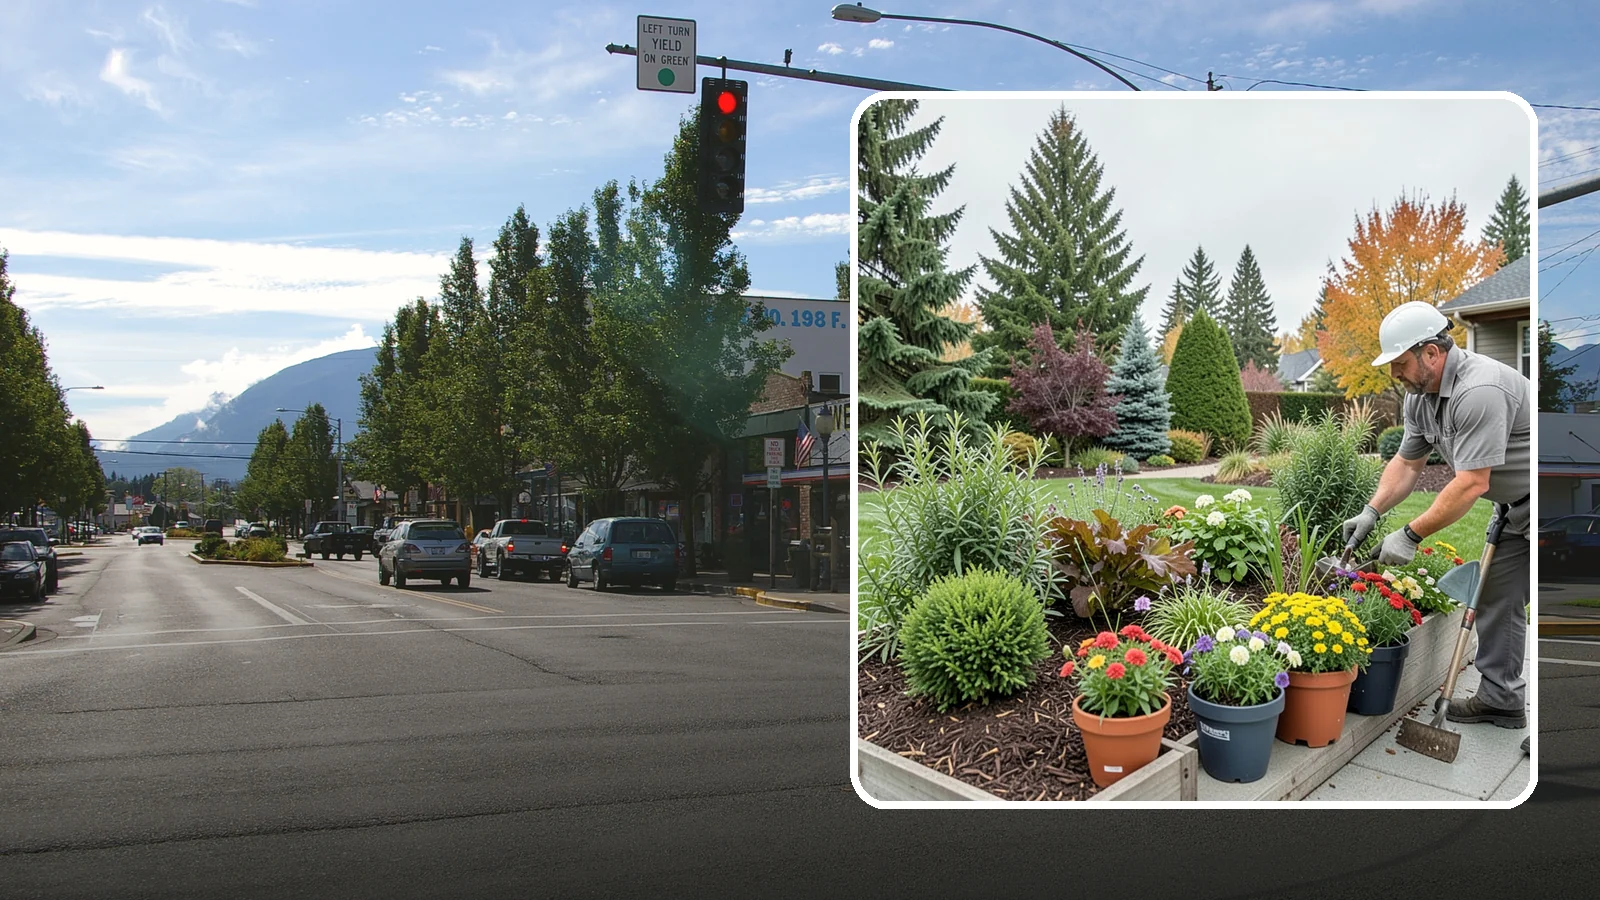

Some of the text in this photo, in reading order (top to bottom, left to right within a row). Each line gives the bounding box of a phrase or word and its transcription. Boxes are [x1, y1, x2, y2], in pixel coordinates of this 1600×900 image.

[643, 23, 690, 37] LEFT TURN
[652, 37, 682, 52] YIELD
[644, 53, 689, 66] ON GREEN
[791, 309, 826, 328] 198
[831, 311, 847, 329] F.
